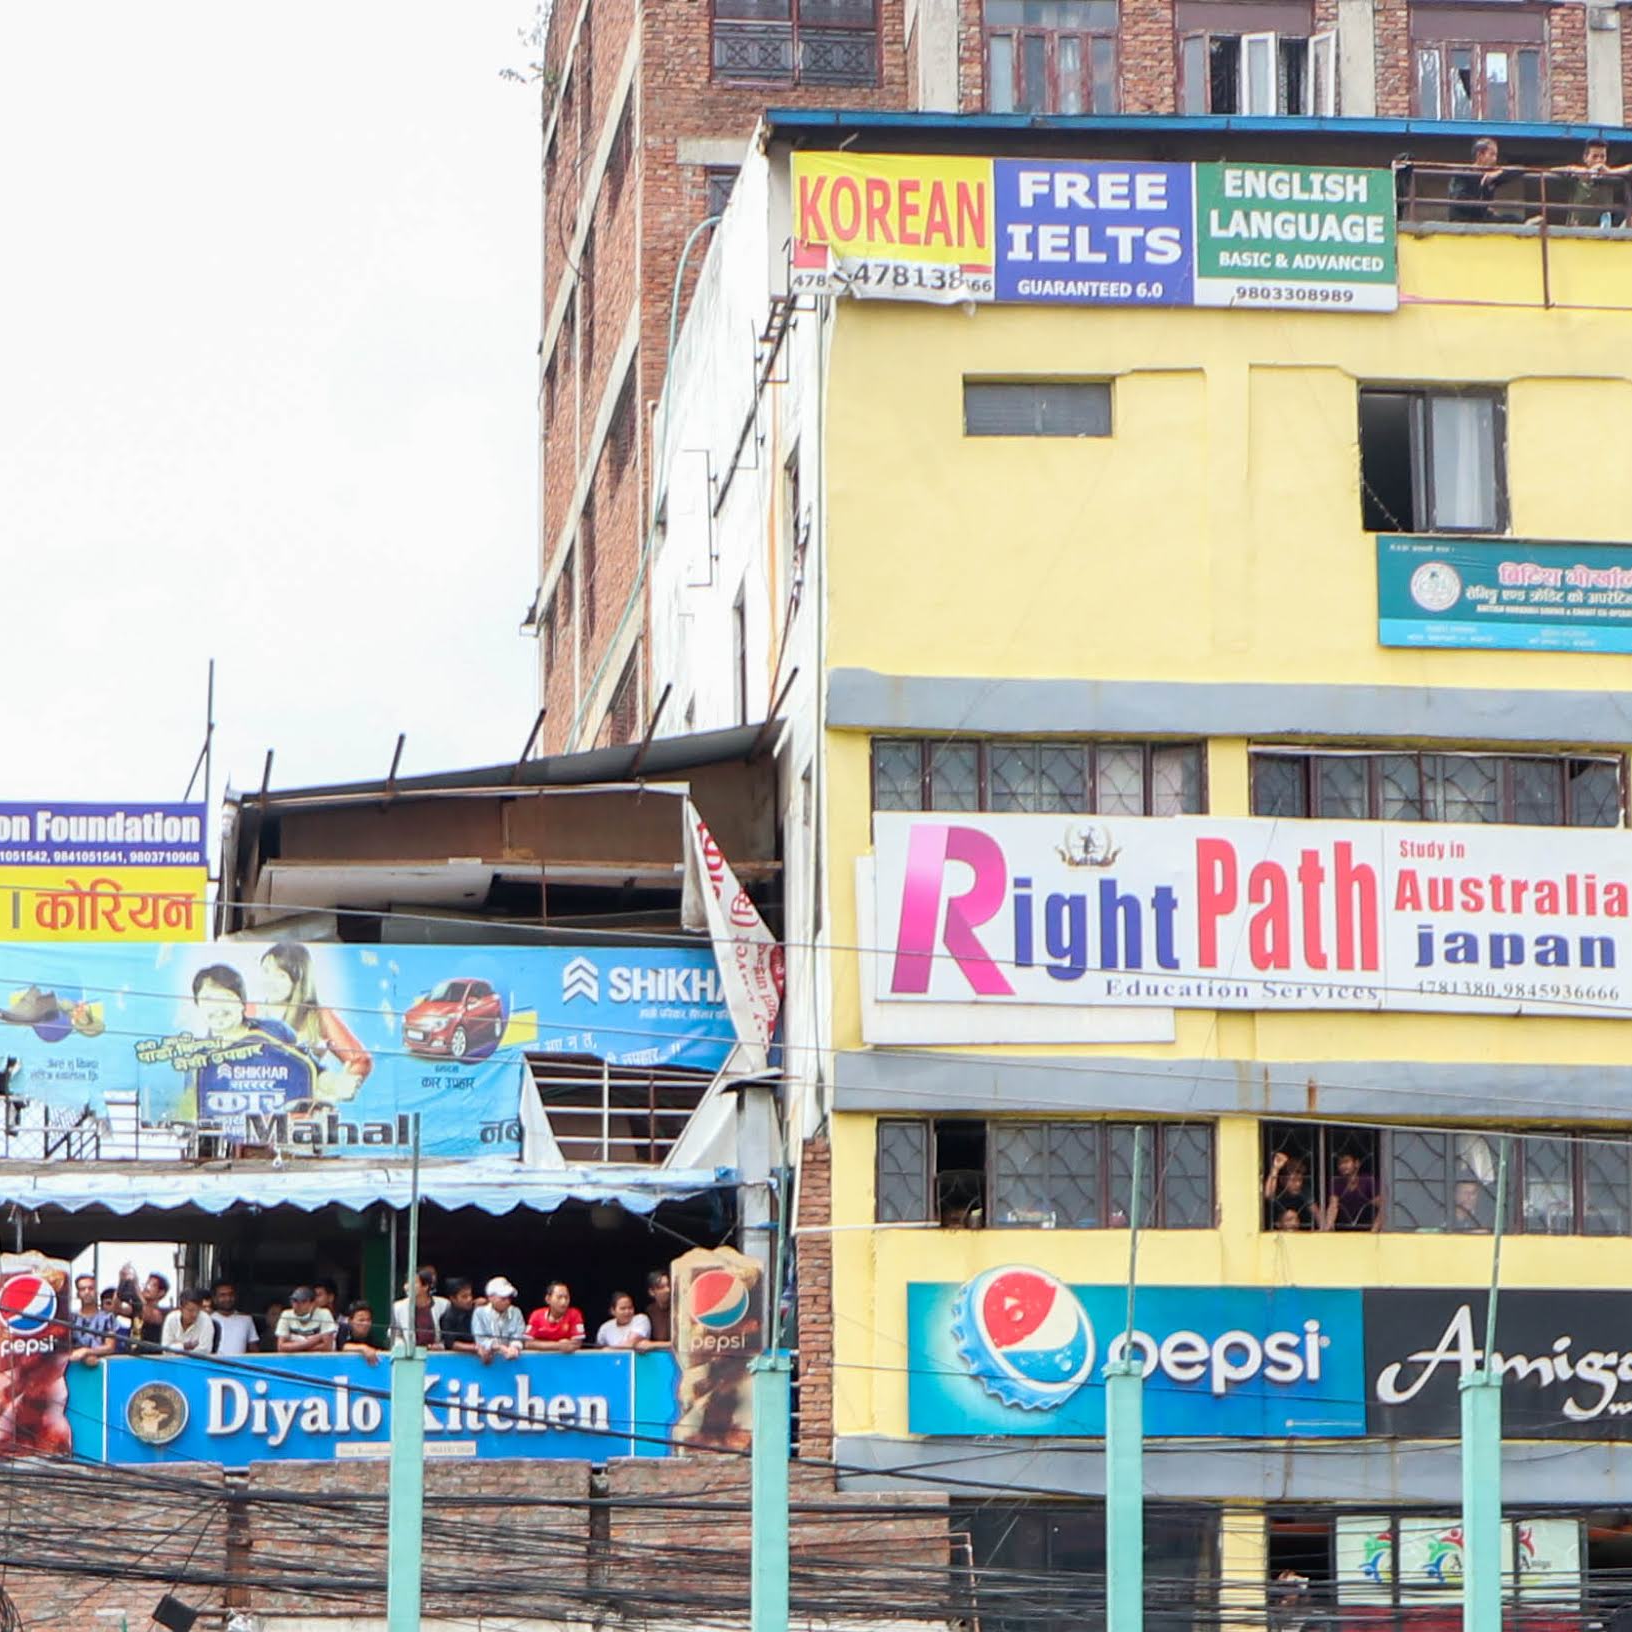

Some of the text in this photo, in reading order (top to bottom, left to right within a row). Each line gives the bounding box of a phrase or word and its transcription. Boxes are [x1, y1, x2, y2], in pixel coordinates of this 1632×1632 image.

[1018, 170, 1167, 210] FREE
[1224, 169, 1368, 204] ENGLISH
[798, 175, 990, 249] KOREAN
[1209, 209, 1385, 244] LANGUAGE
[1007, 223, 1183, 264] IELTS
[1219, 250, 1384, 273] BASIC & ADVANCED
[1018, 280, 1163, 298] GUARANTEED 6.0
[1236, 285, 1354, 304] 9803308989
[36, 810, 200, 842] Foundation
[1400, 839, 1465, 860] Study in
[35, 878, 196, 931] कोरियन
[889, 823, 1179, 997] Right
[1196, 837, 1380, 972] Path
[1394, 868, 1630, 918] Australia
[1415, 925, 1616, 969] japan
[1106, 979, 1379, 1001] Education Services
[233, 1065, 289, 1080] SHIKHAR
[0, 1336, 54, 1357] pepsi
[691, 1331, 746, 1354] pepsi
[207, 1376, 381, 1446] Diyalo
